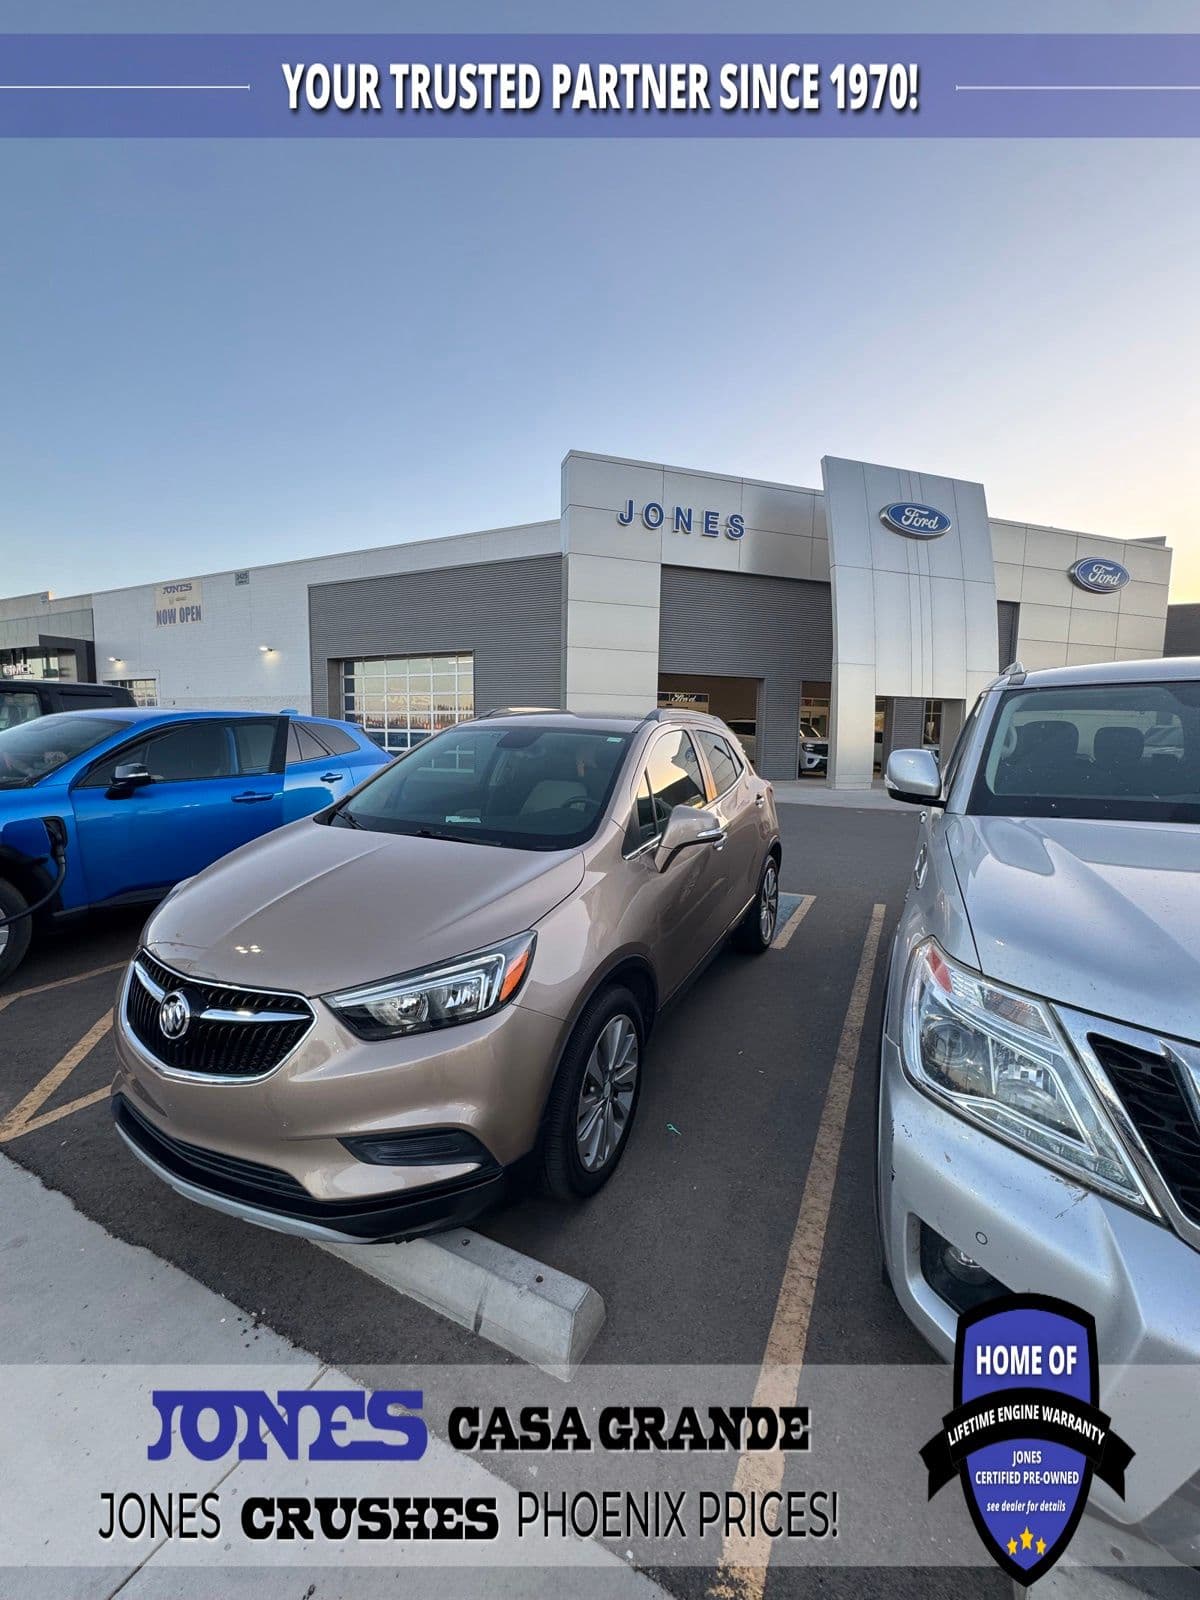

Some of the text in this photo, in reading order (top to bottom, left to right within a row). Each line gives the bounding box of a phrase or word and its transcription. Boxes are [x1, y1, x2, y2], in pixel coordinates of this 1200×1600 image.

[618, 498, 745, 540] JONES
[901, 507, 939, 530] Ford
[1088, 564, 1121, 586] Ford
[161, 583, 193, 595] JONES
[156, 604, 202, 626] NOW OPEN
